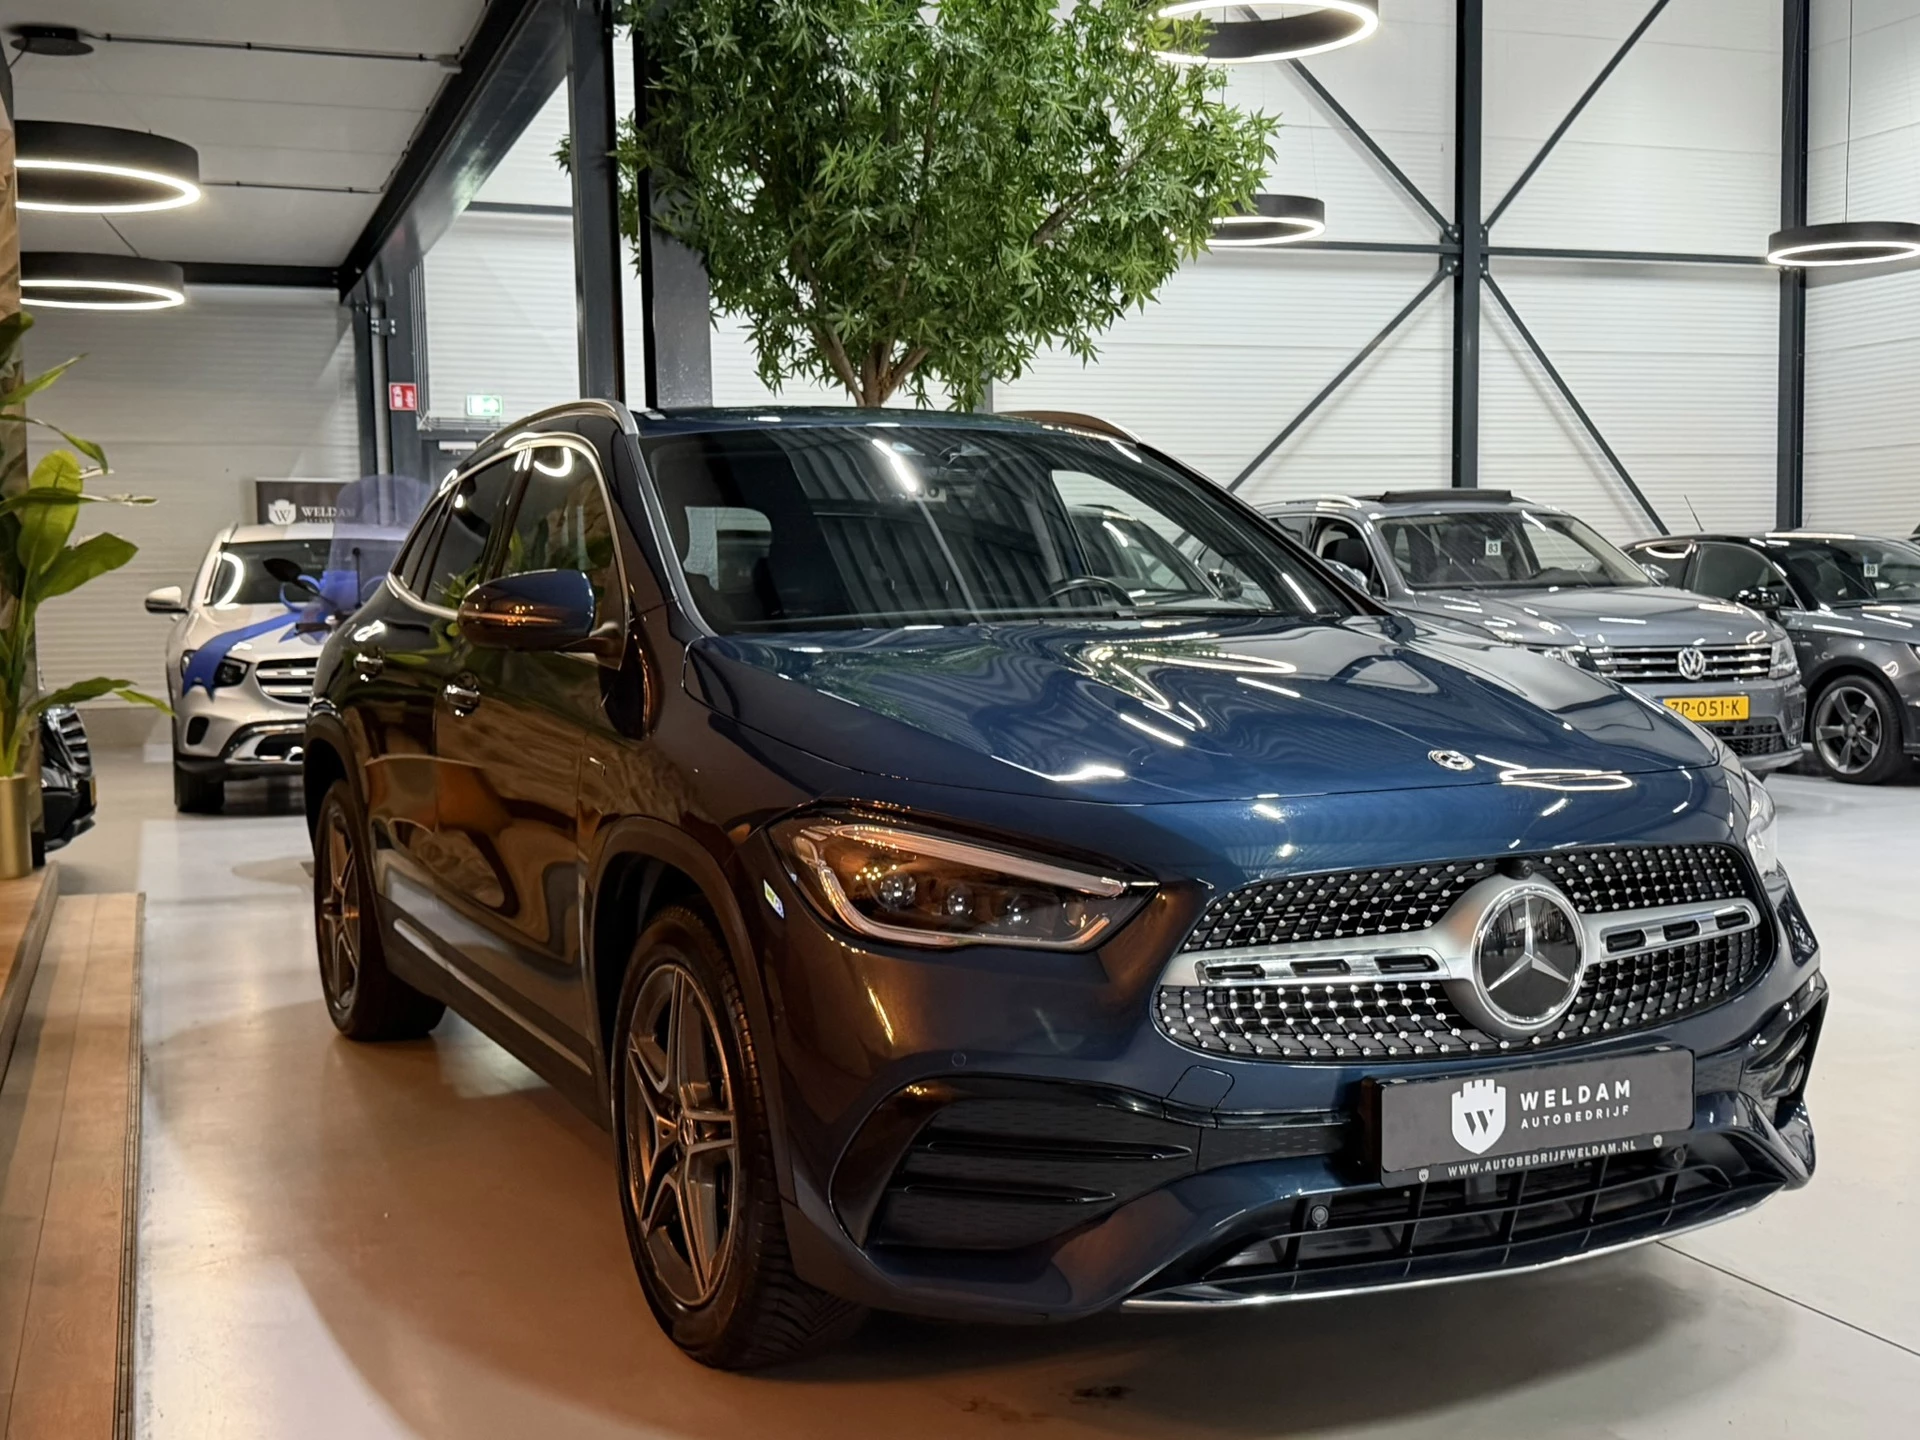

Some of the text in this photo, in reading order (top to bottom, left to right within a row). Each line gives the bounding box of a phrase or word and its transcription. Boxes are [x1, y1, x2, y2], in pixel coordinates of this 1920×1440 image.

[1488, 543, 1498, 553] 83
[1520, 1080, 1631, 1111] WELDAM
[1463, 1108, 1494, 1136] W
[1521, 1104, 1630, 1130] AUTOBEDRIJF
[1447, 1140, 1637, 1178] WWW.AUTOBEDRIJFWELDAM.NL
